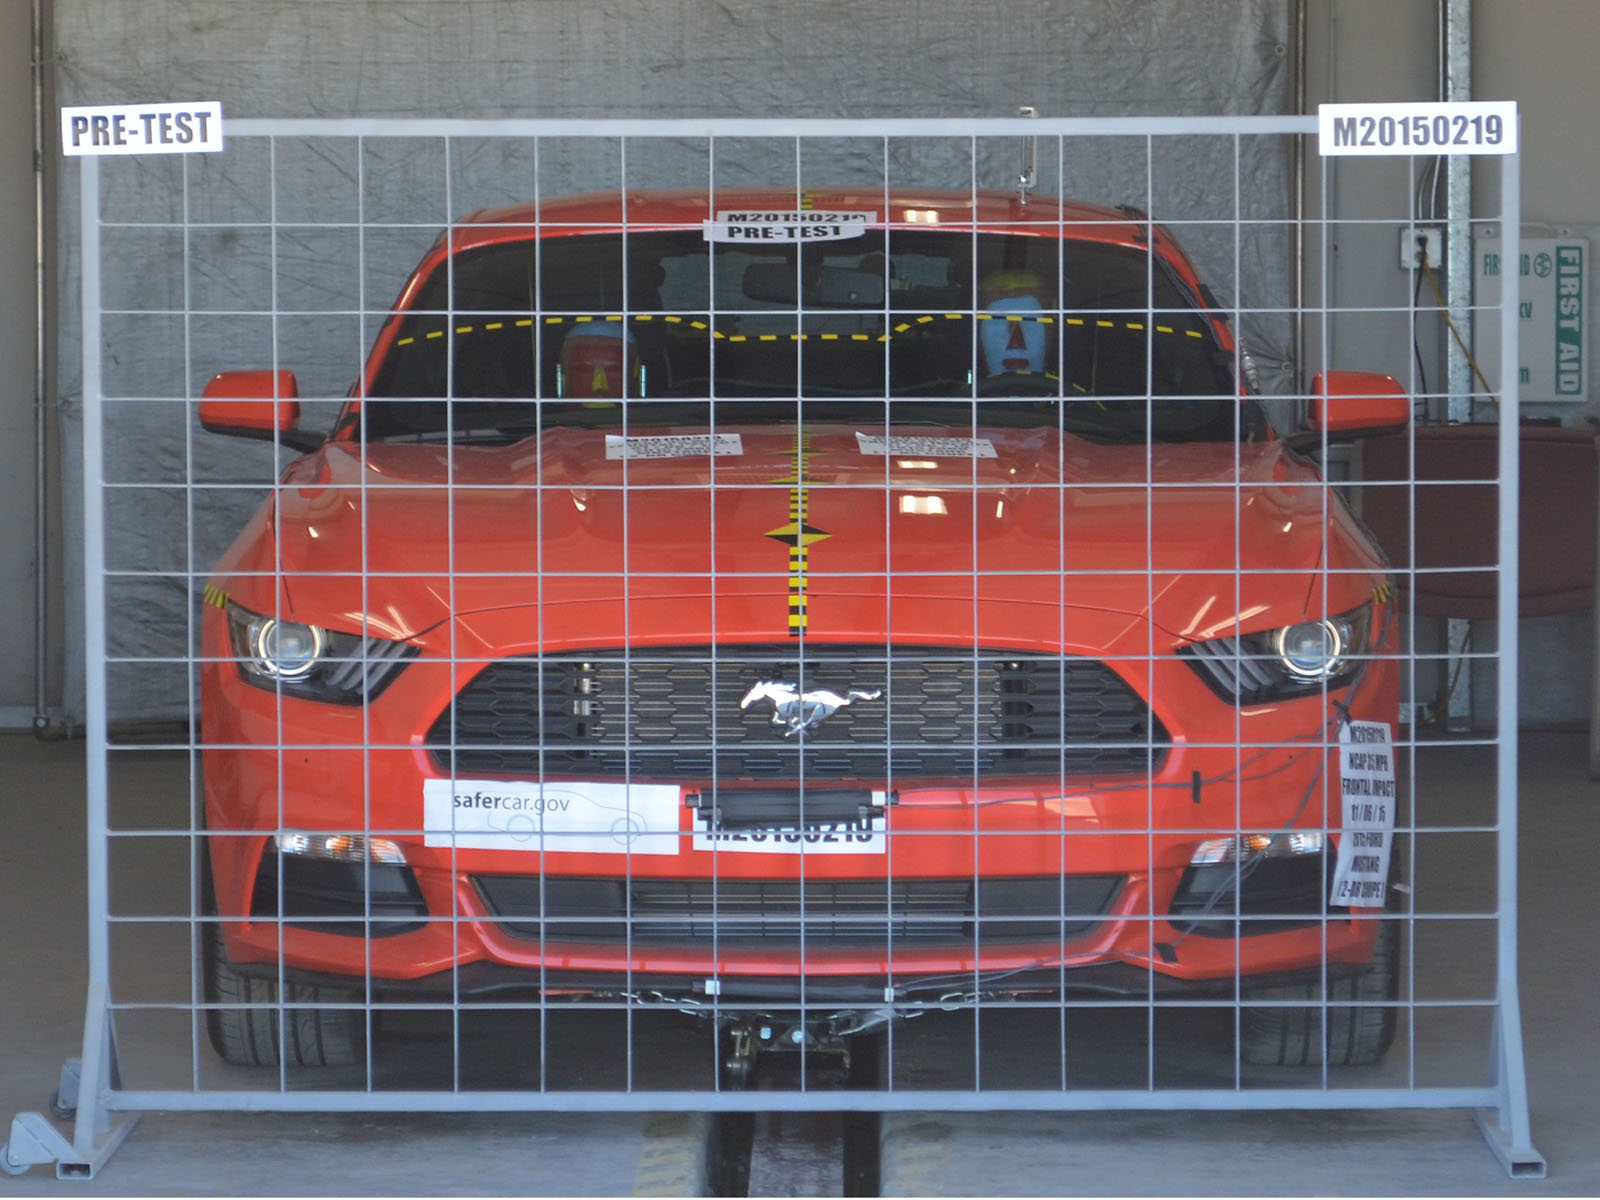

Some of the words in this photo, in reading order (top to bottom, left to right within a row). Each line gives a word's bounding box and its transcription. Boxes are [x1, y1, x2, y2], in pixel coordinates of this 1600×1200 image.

[71, 112, 212, 147] PRE-TEST
[1333, 114, 1504, 147] M20150219
[727, 226, 841, 239] PRE-TEST
[1559, 249, 1580, 332] FIRST
[1559, 342, 1580, 392] AID
[453, 792, 569, 815] safercar.gov
